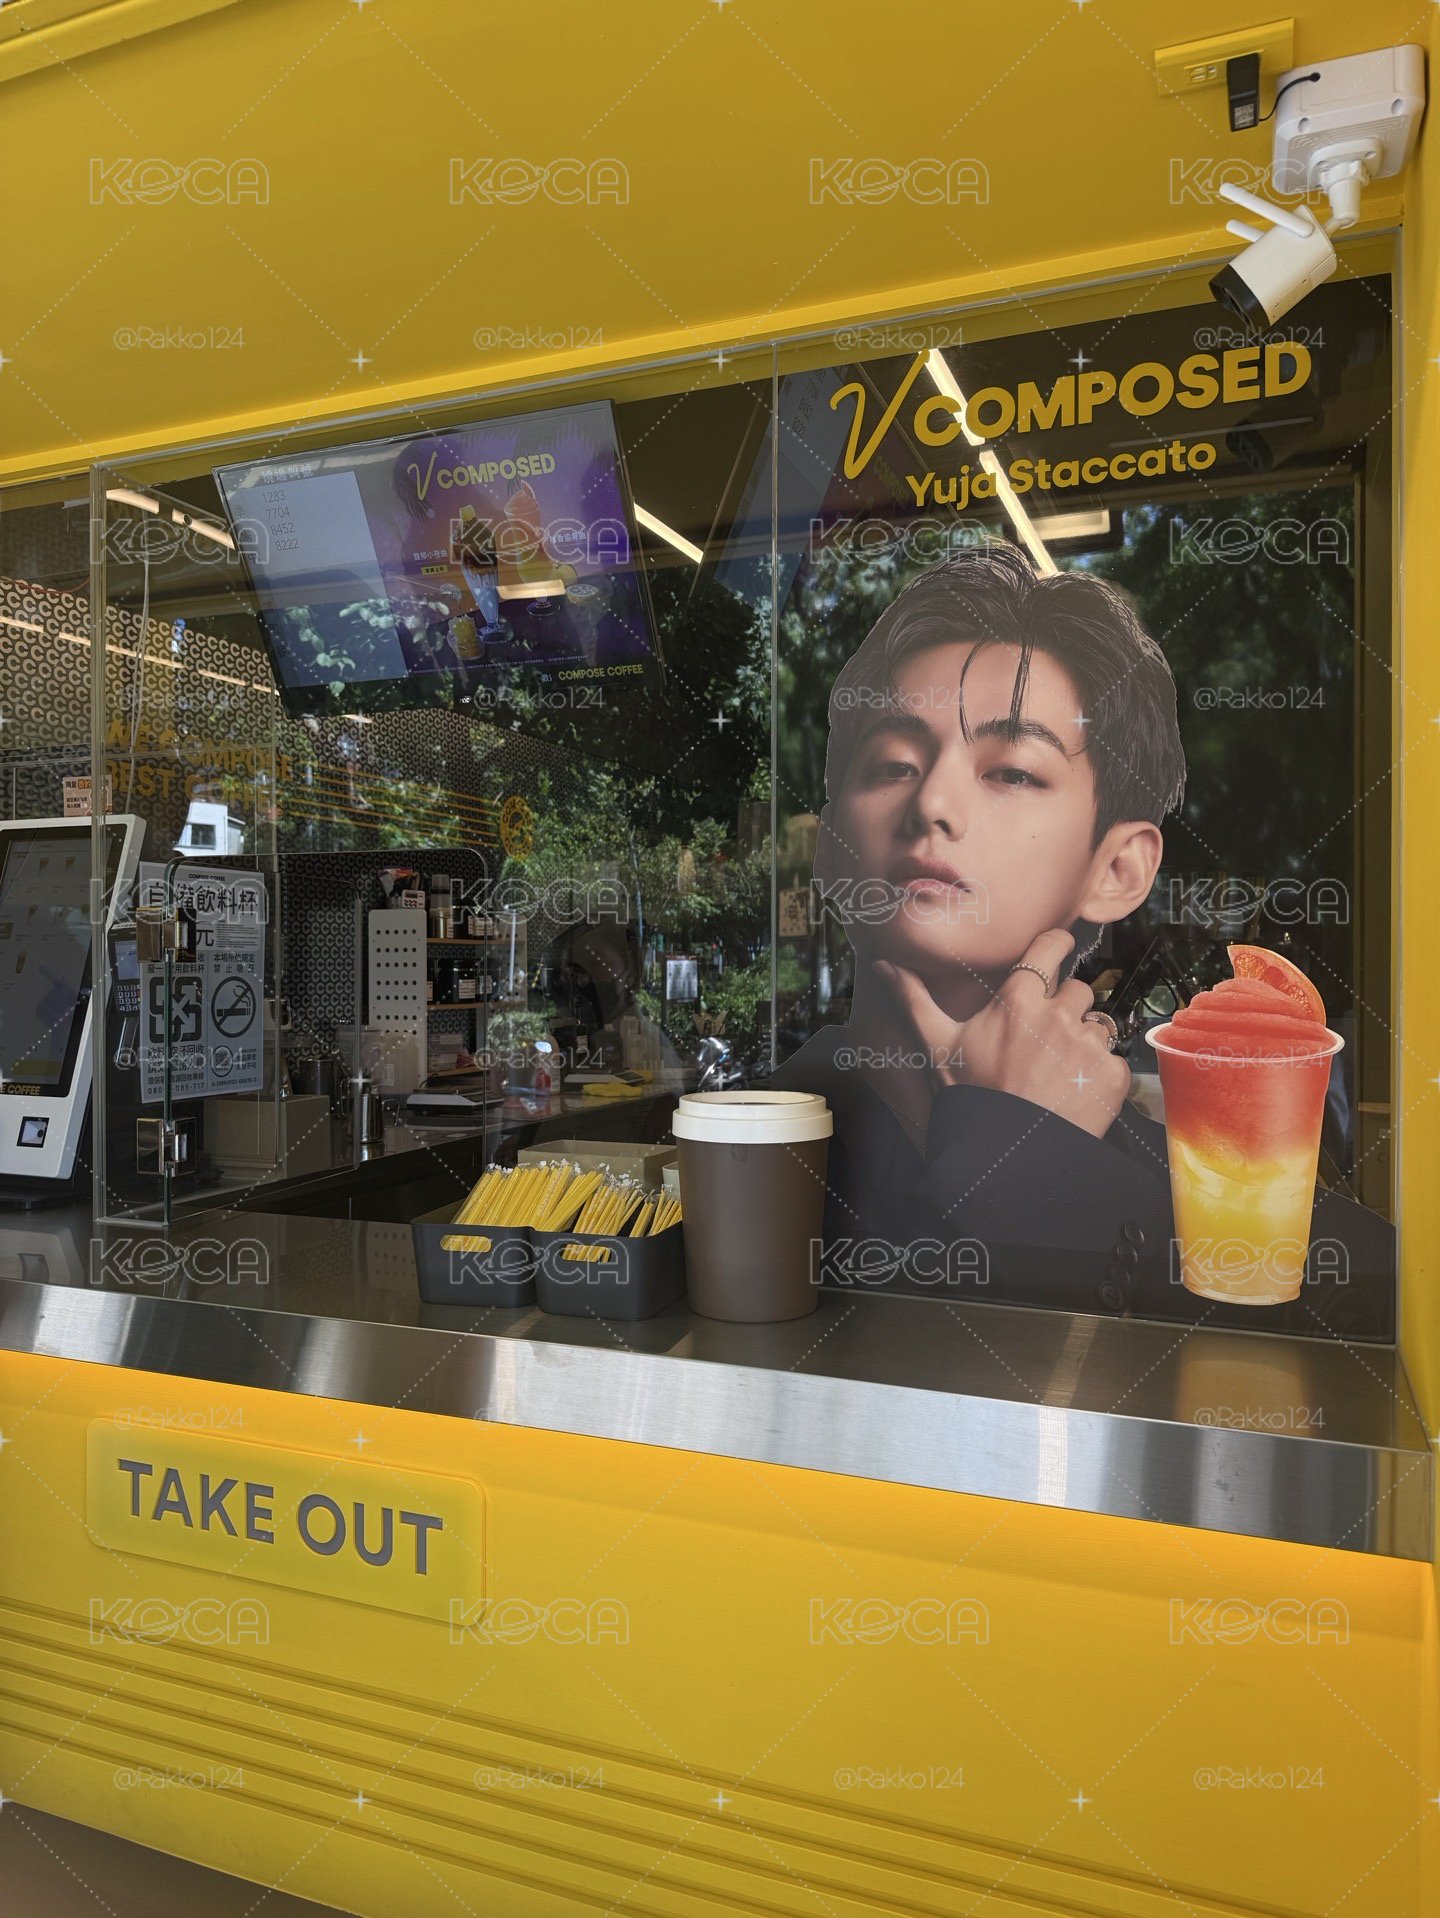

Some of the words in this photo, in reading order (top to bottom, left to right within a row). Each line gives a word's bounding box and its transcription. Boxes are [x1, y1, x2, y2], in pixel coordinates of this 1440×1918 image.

[830, 349, 930, 479] V
[913, 341, 1312, 448] COMPOSED
[436, 453, 557, 489] COMPOSED
[906, 470, 998, 511] Yuja
[1009, 440, 1217, 493] Staccato
[262, 490, 286, 503] 1283
[265, 506, 290, 519] 7704
[270, 522, 295, 536] 8452
[275, 538, 300, 551] 8222
[558, 668, 605, 681] COMPOSE
[607, 663, 644, 677] COFFEE
[7, 1085, 41, 1096] COFFEE
[117, 1458, 275, 1544] TAKE
[297, 1494, 444, 1576] OUT
